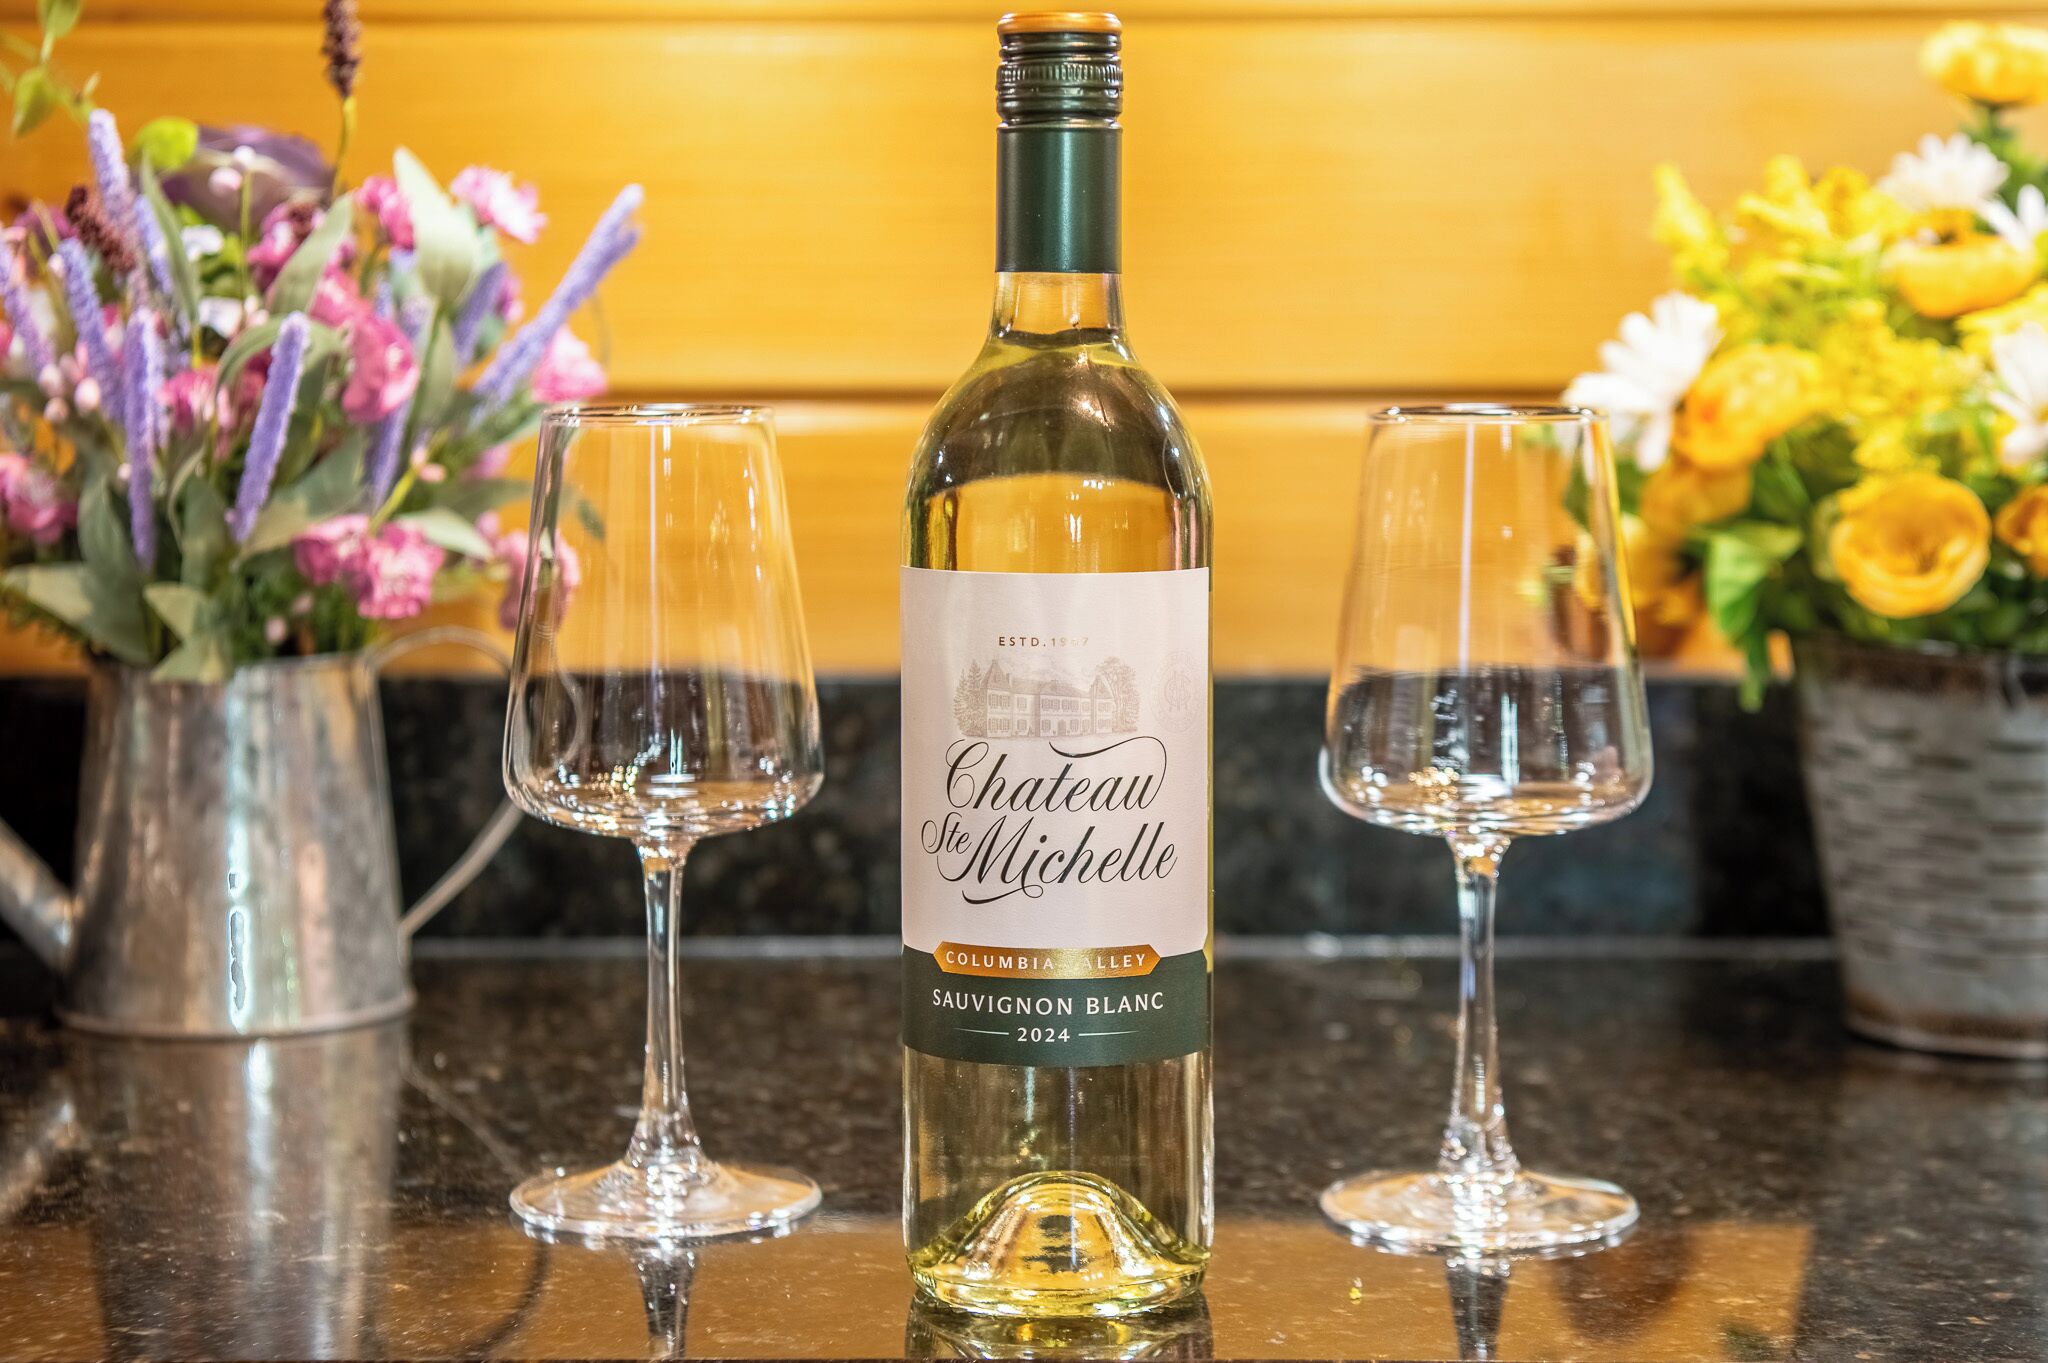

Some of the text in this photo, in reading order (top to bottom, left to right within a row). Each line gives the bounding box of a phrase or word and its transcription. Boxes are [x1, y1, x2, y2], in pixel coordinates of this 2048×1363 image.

[945, 736, 1167, 812] Chateau
[920, 811, 1178, 905] Ste Michelle
[945, 951, 1146, 971] COLUMBIA ALLEY
[932, 988, 1164, 1016] SAUVIGNON BLANC
[1016, 1027, 1071, 1043] 2024
